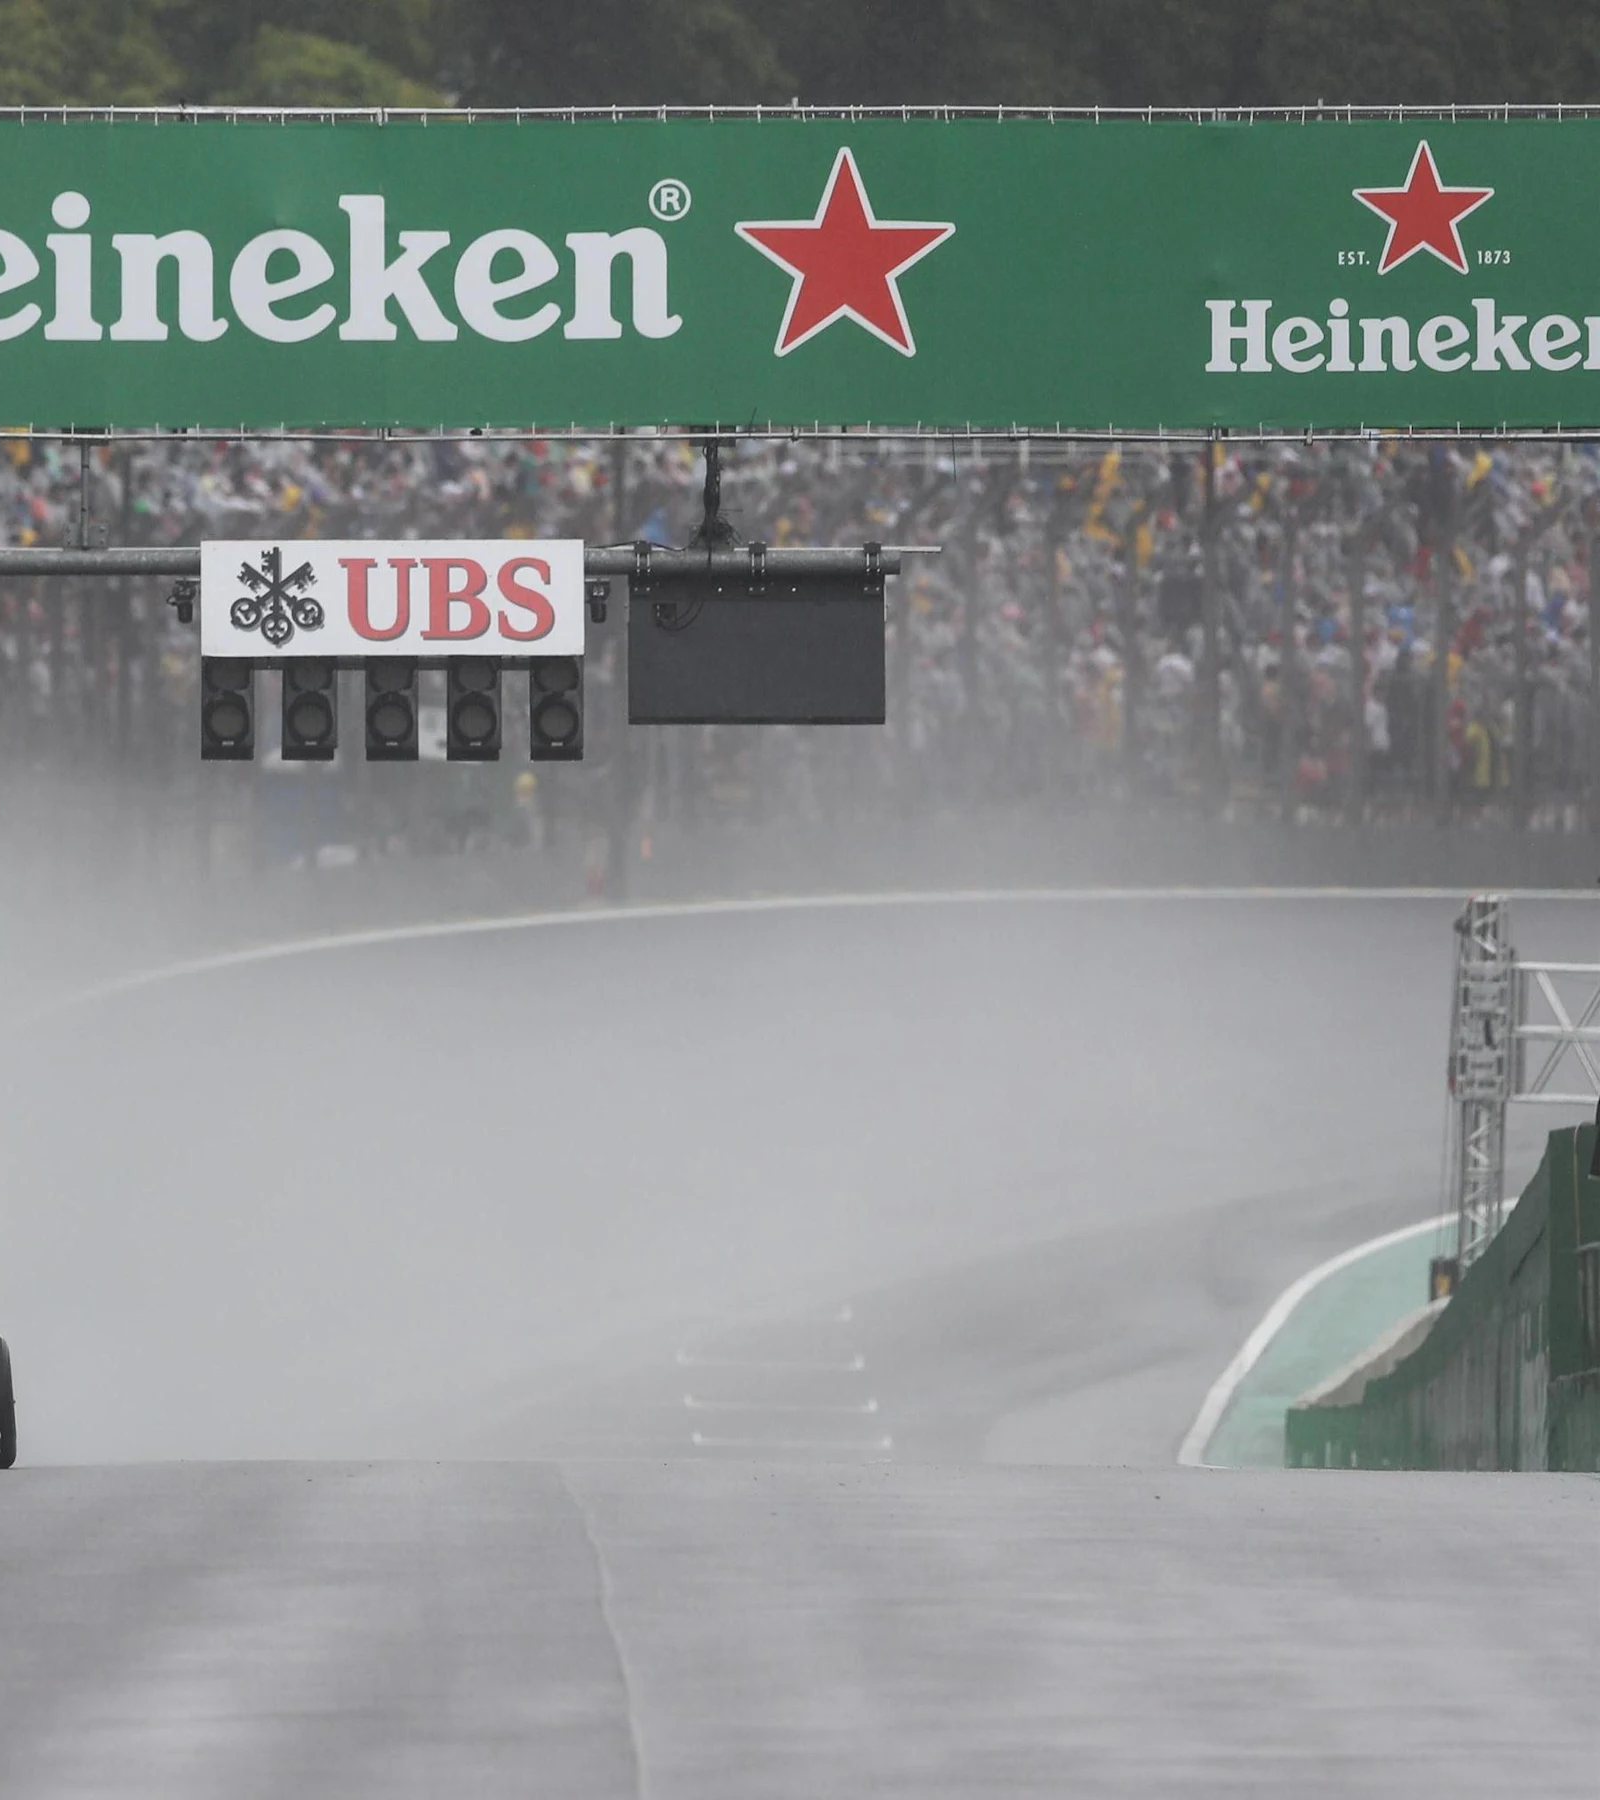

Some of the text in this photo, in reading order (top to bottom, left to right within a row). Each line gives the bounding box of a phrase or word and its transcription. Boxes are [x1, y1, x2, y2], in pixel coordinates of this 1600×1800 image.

[1338, 250, 1511, 265] EST. 1873
[339, 556, 554, 640] UBS
